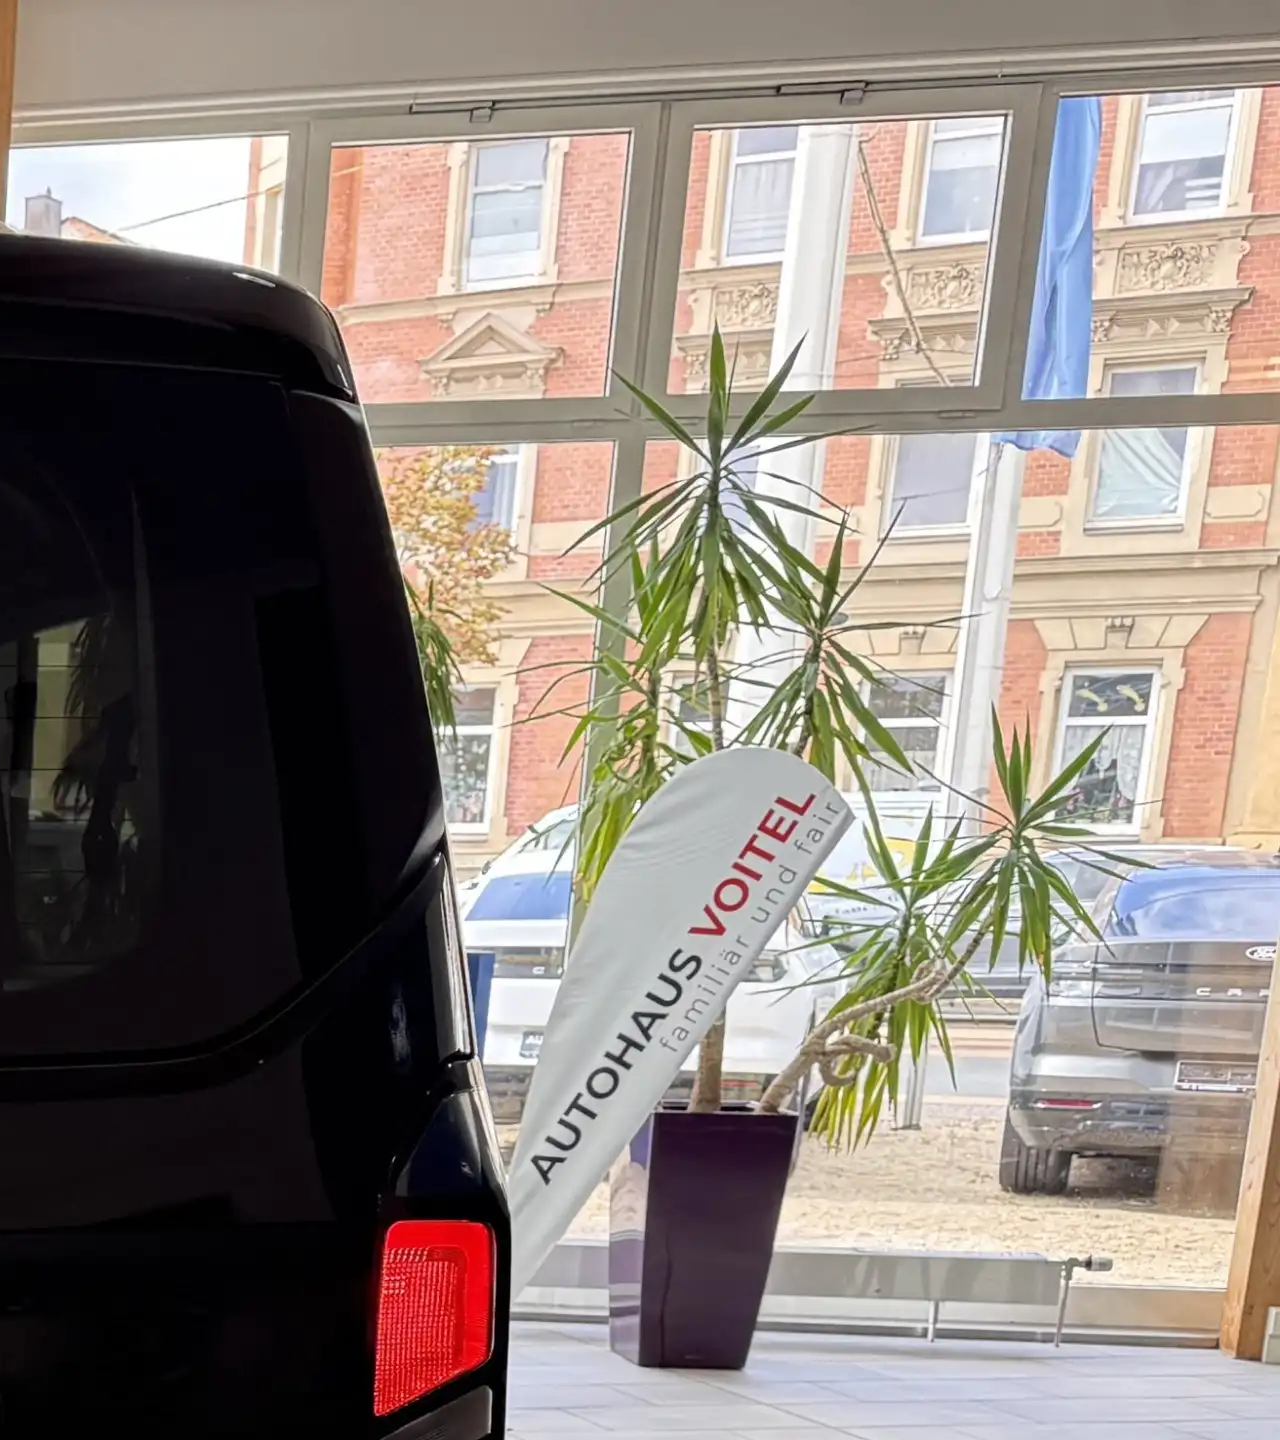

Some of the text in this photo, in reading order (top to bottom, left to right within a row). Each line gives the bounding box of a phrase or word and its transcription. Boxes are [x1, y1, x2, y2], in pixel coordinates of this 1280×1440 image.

[529, 790, 817, 1185] AUTOHAUS VOITEL
[659, 800, 841, 1053] familiär und fair
